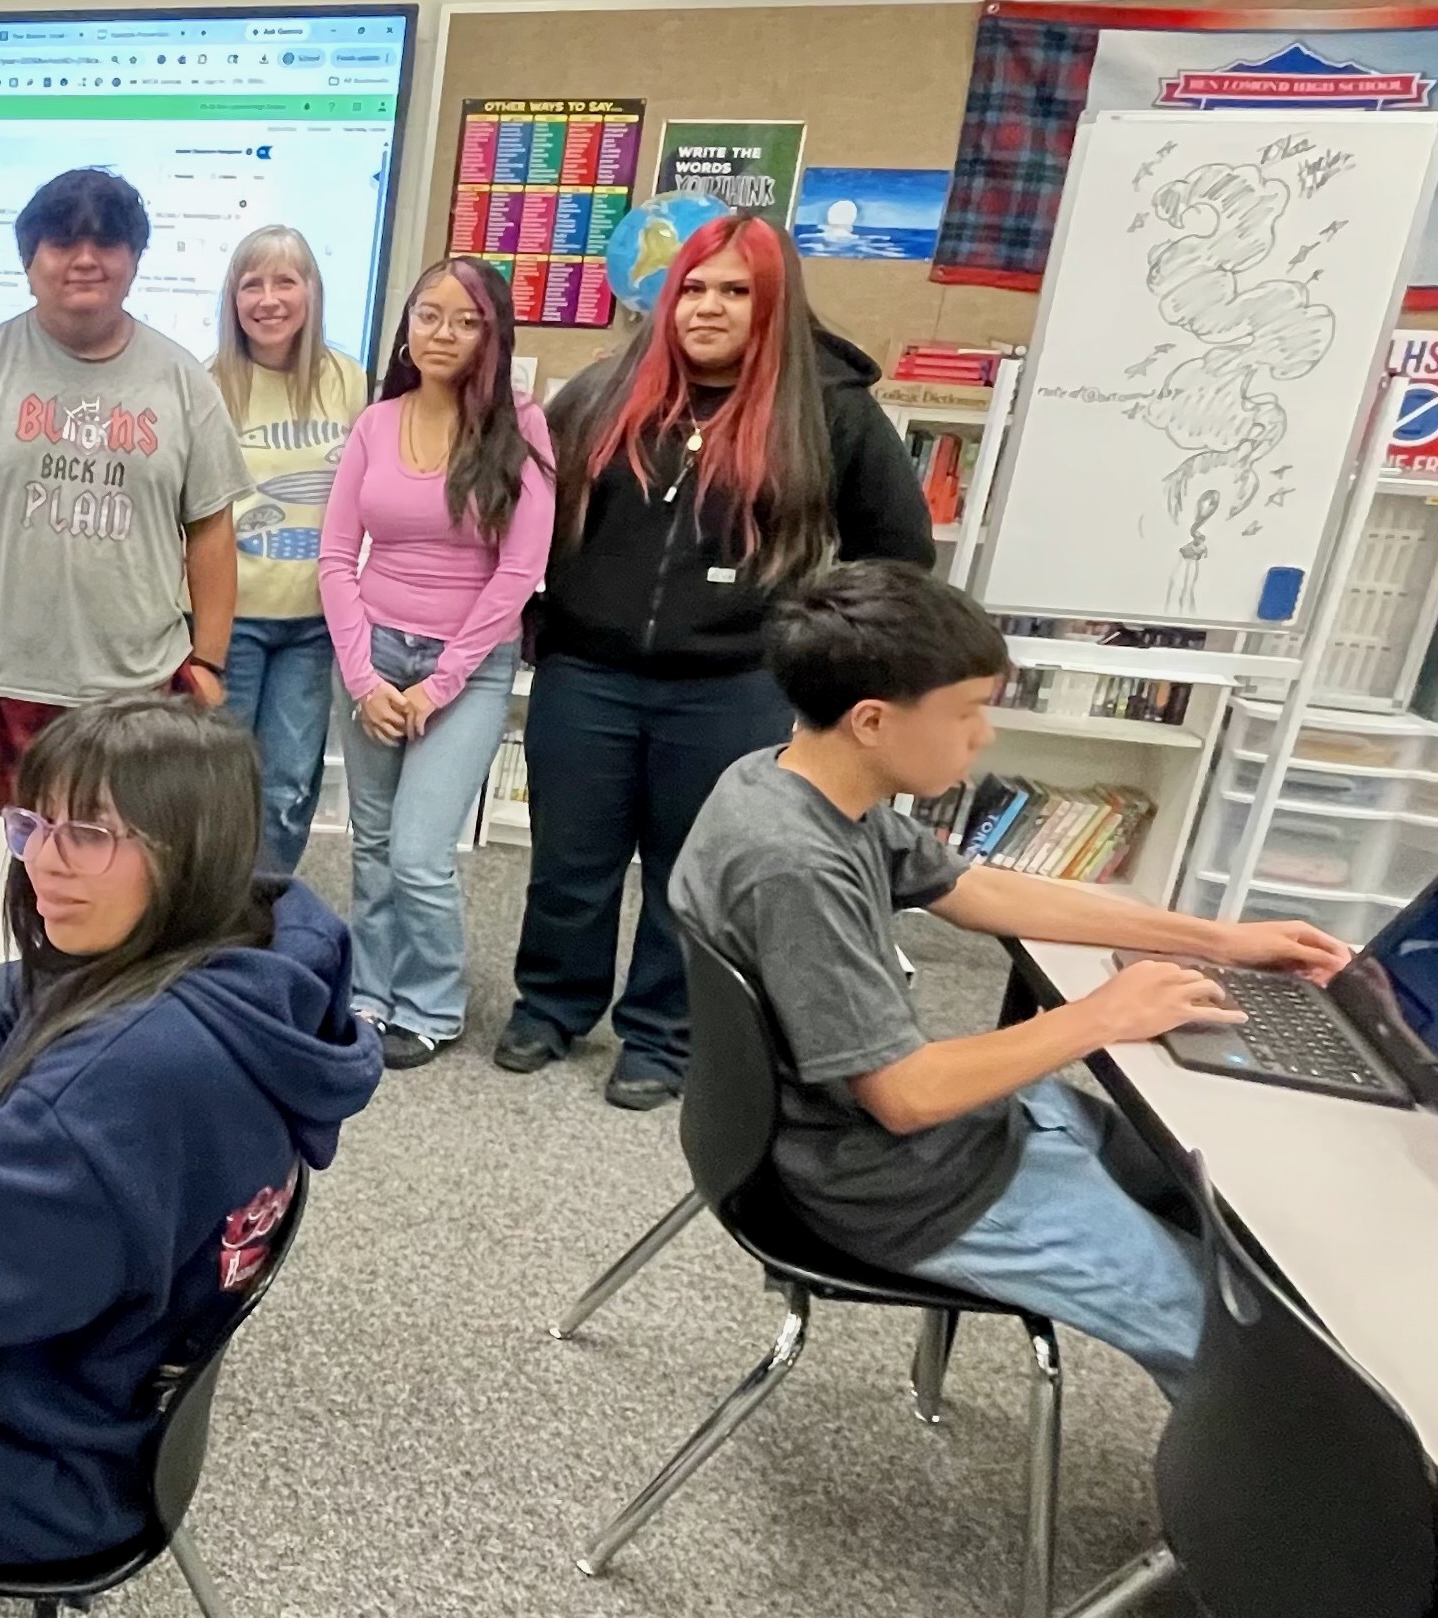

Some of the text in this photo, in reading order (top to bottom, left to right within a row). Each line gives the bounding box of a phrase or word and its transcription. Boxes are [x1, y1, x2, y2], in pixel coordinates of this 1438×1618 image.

[1222, 79, 1290, 92] LOMOND
[1292, 81, 1335, 93] HIGH
[1338, 80, 1403, 92] SCHOOL
[484, 101, 526, 112] OTHER
[529, 101, 564, 112] WAYS
[567, 102, 586, 112] TO
[678, 146, 762, 159] WRITE THE
[675, 161, 732, 174] WORDS
[40, 452, 125, 488] BACK IN
[22, 481, 134, 541] PLAID
